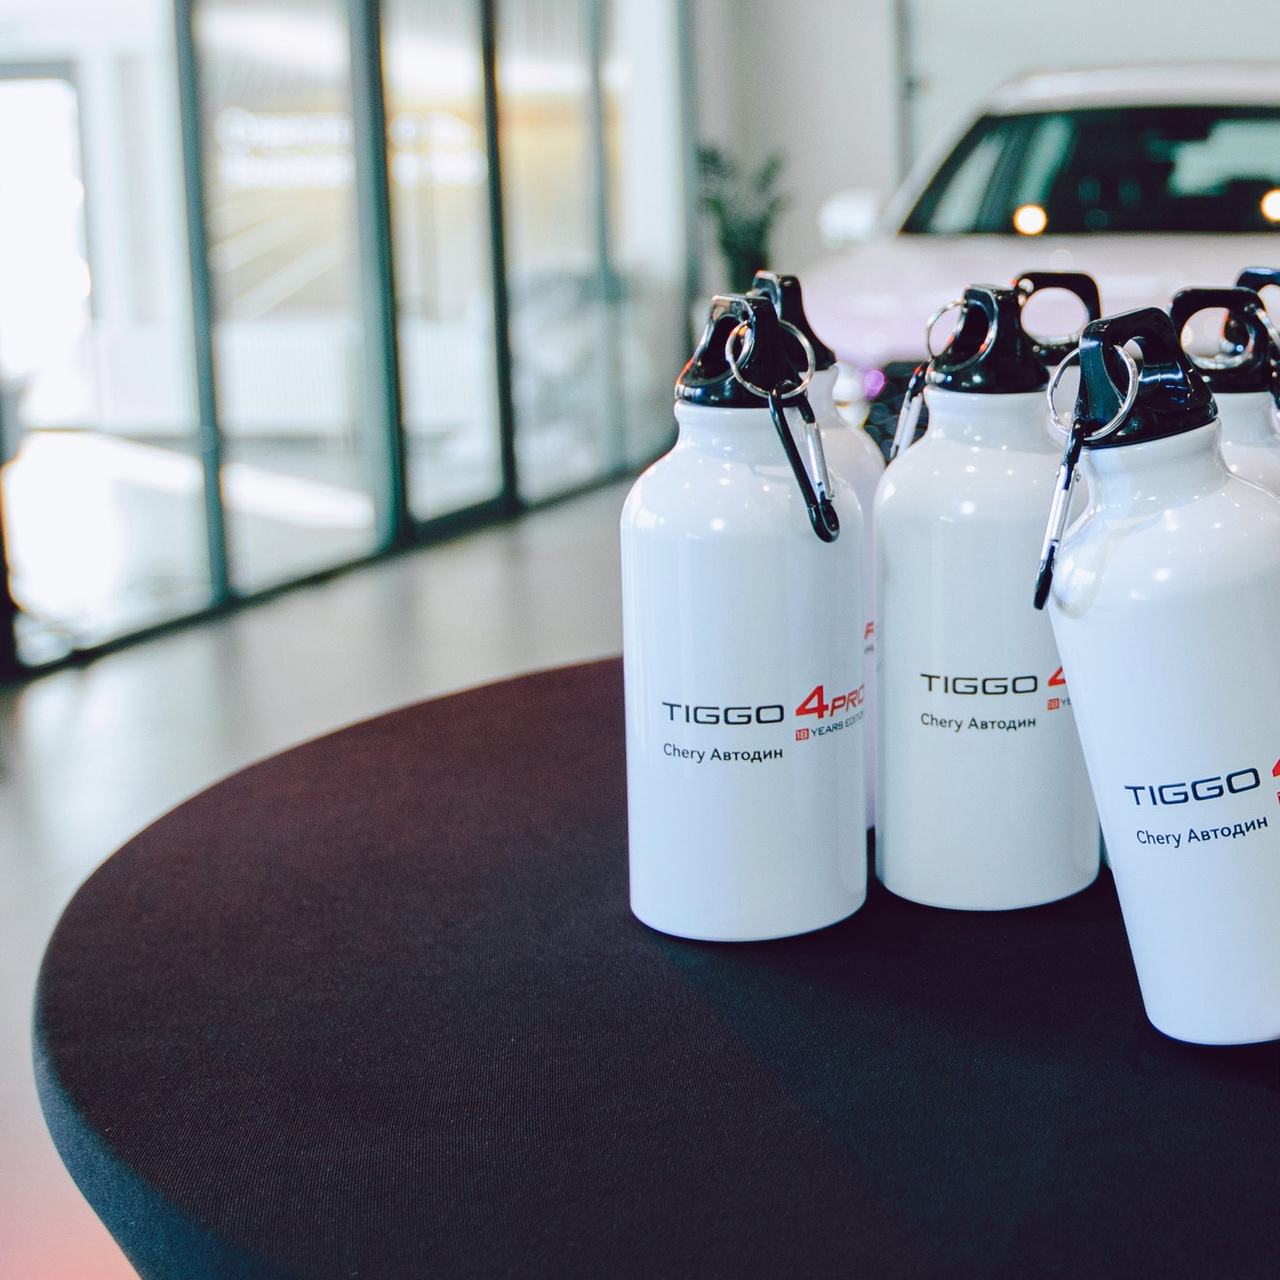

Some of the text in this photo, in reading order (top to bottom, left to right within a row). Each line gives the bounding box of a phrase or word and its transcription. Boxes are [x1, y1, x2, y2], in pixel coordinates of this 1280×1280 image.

[919, 672, 1039, 696] TIGGO
[661, 701, 785, 726] TIGGO
[920, 713, 1037, 732] Chery Автодин
[796, 728, 809, 741] 18
[811, 721, 844, 737] YEARS
[663, 743, 783, 764] Chery Автодин
[1124, 767, 1261, 806] TIGGO
[1136, 816, 1269, 848] Chery Автодин
